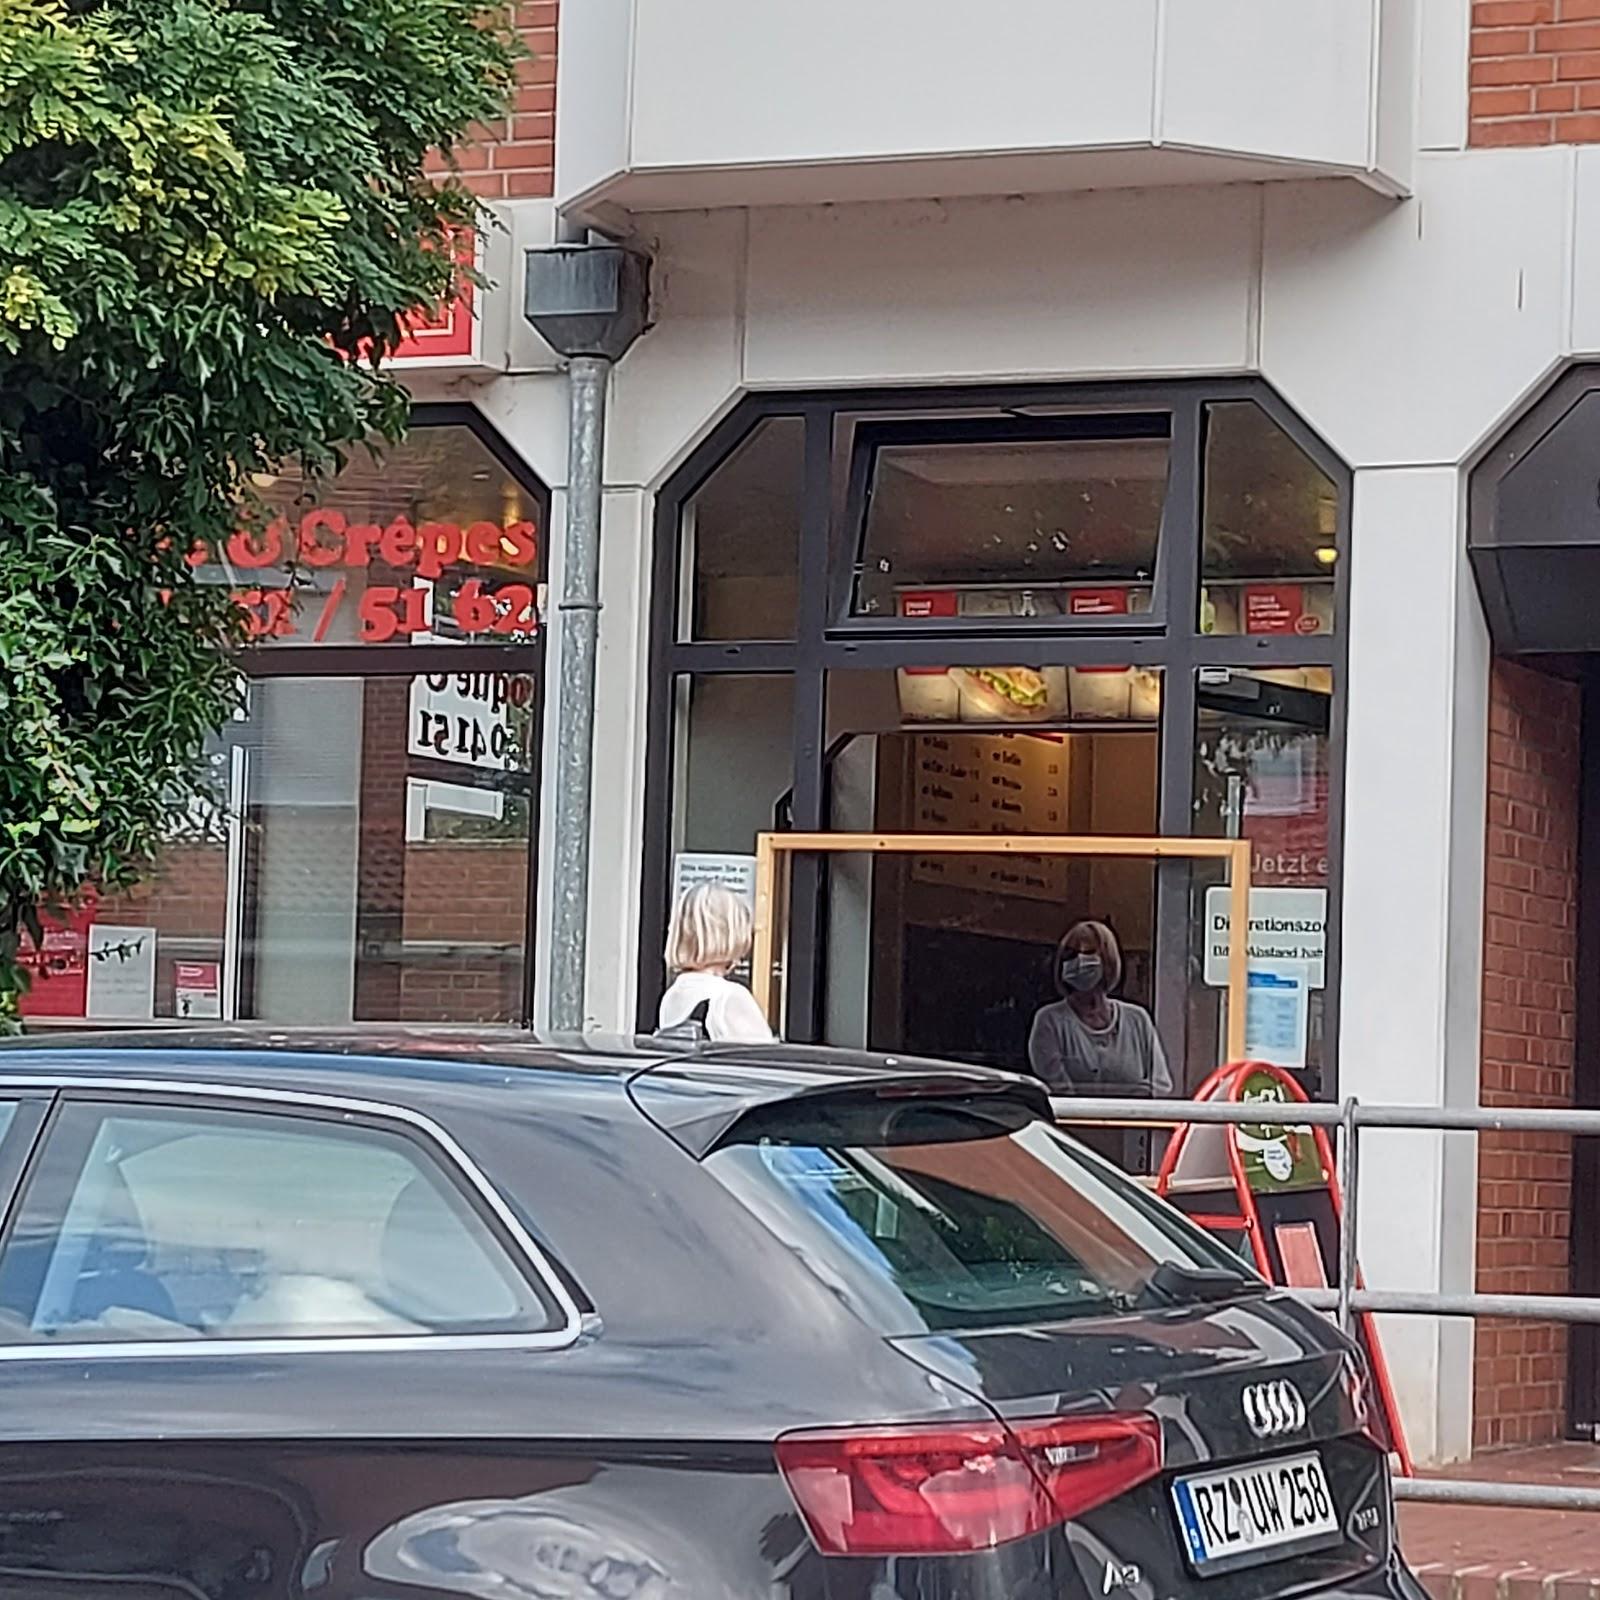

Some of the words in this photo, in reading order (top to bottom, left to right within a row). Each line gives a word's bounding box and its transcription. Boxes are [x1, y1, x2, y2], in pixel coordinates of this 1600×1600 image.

[300, 508, 536, 578] Crêpes
[358, 586, 433, 643] 51
[452, 578, 537, 634] 62
[1252, 853, 1310, 874] Jetzt
[1195, 1481, 1241, 1548] RZ
[1279, 1463, 1329, 1529] 258
